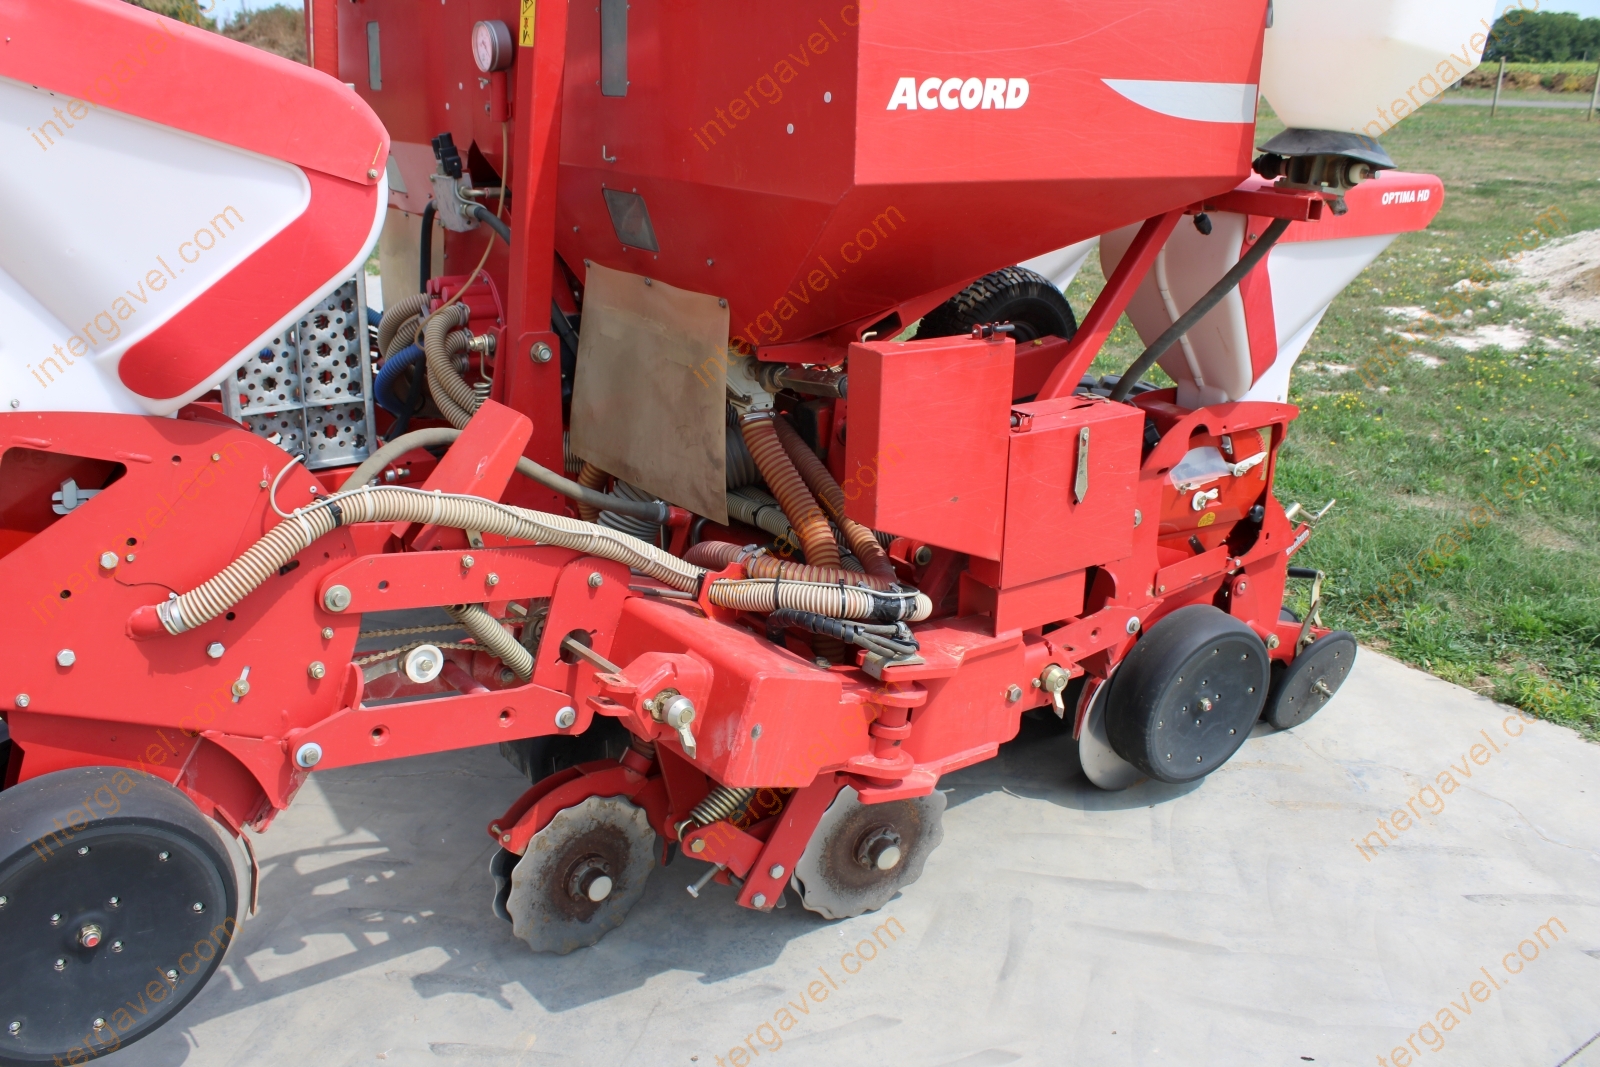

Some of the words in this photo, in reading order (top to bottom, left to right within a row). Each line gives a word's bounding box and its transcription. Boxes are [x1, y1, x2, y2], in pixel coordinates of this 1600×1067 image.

[886, 77, 1030, 110] ACCORD
[1381, 190, 1416, 205] OPTIMA
[1416, 189, 1430, 202] HD
